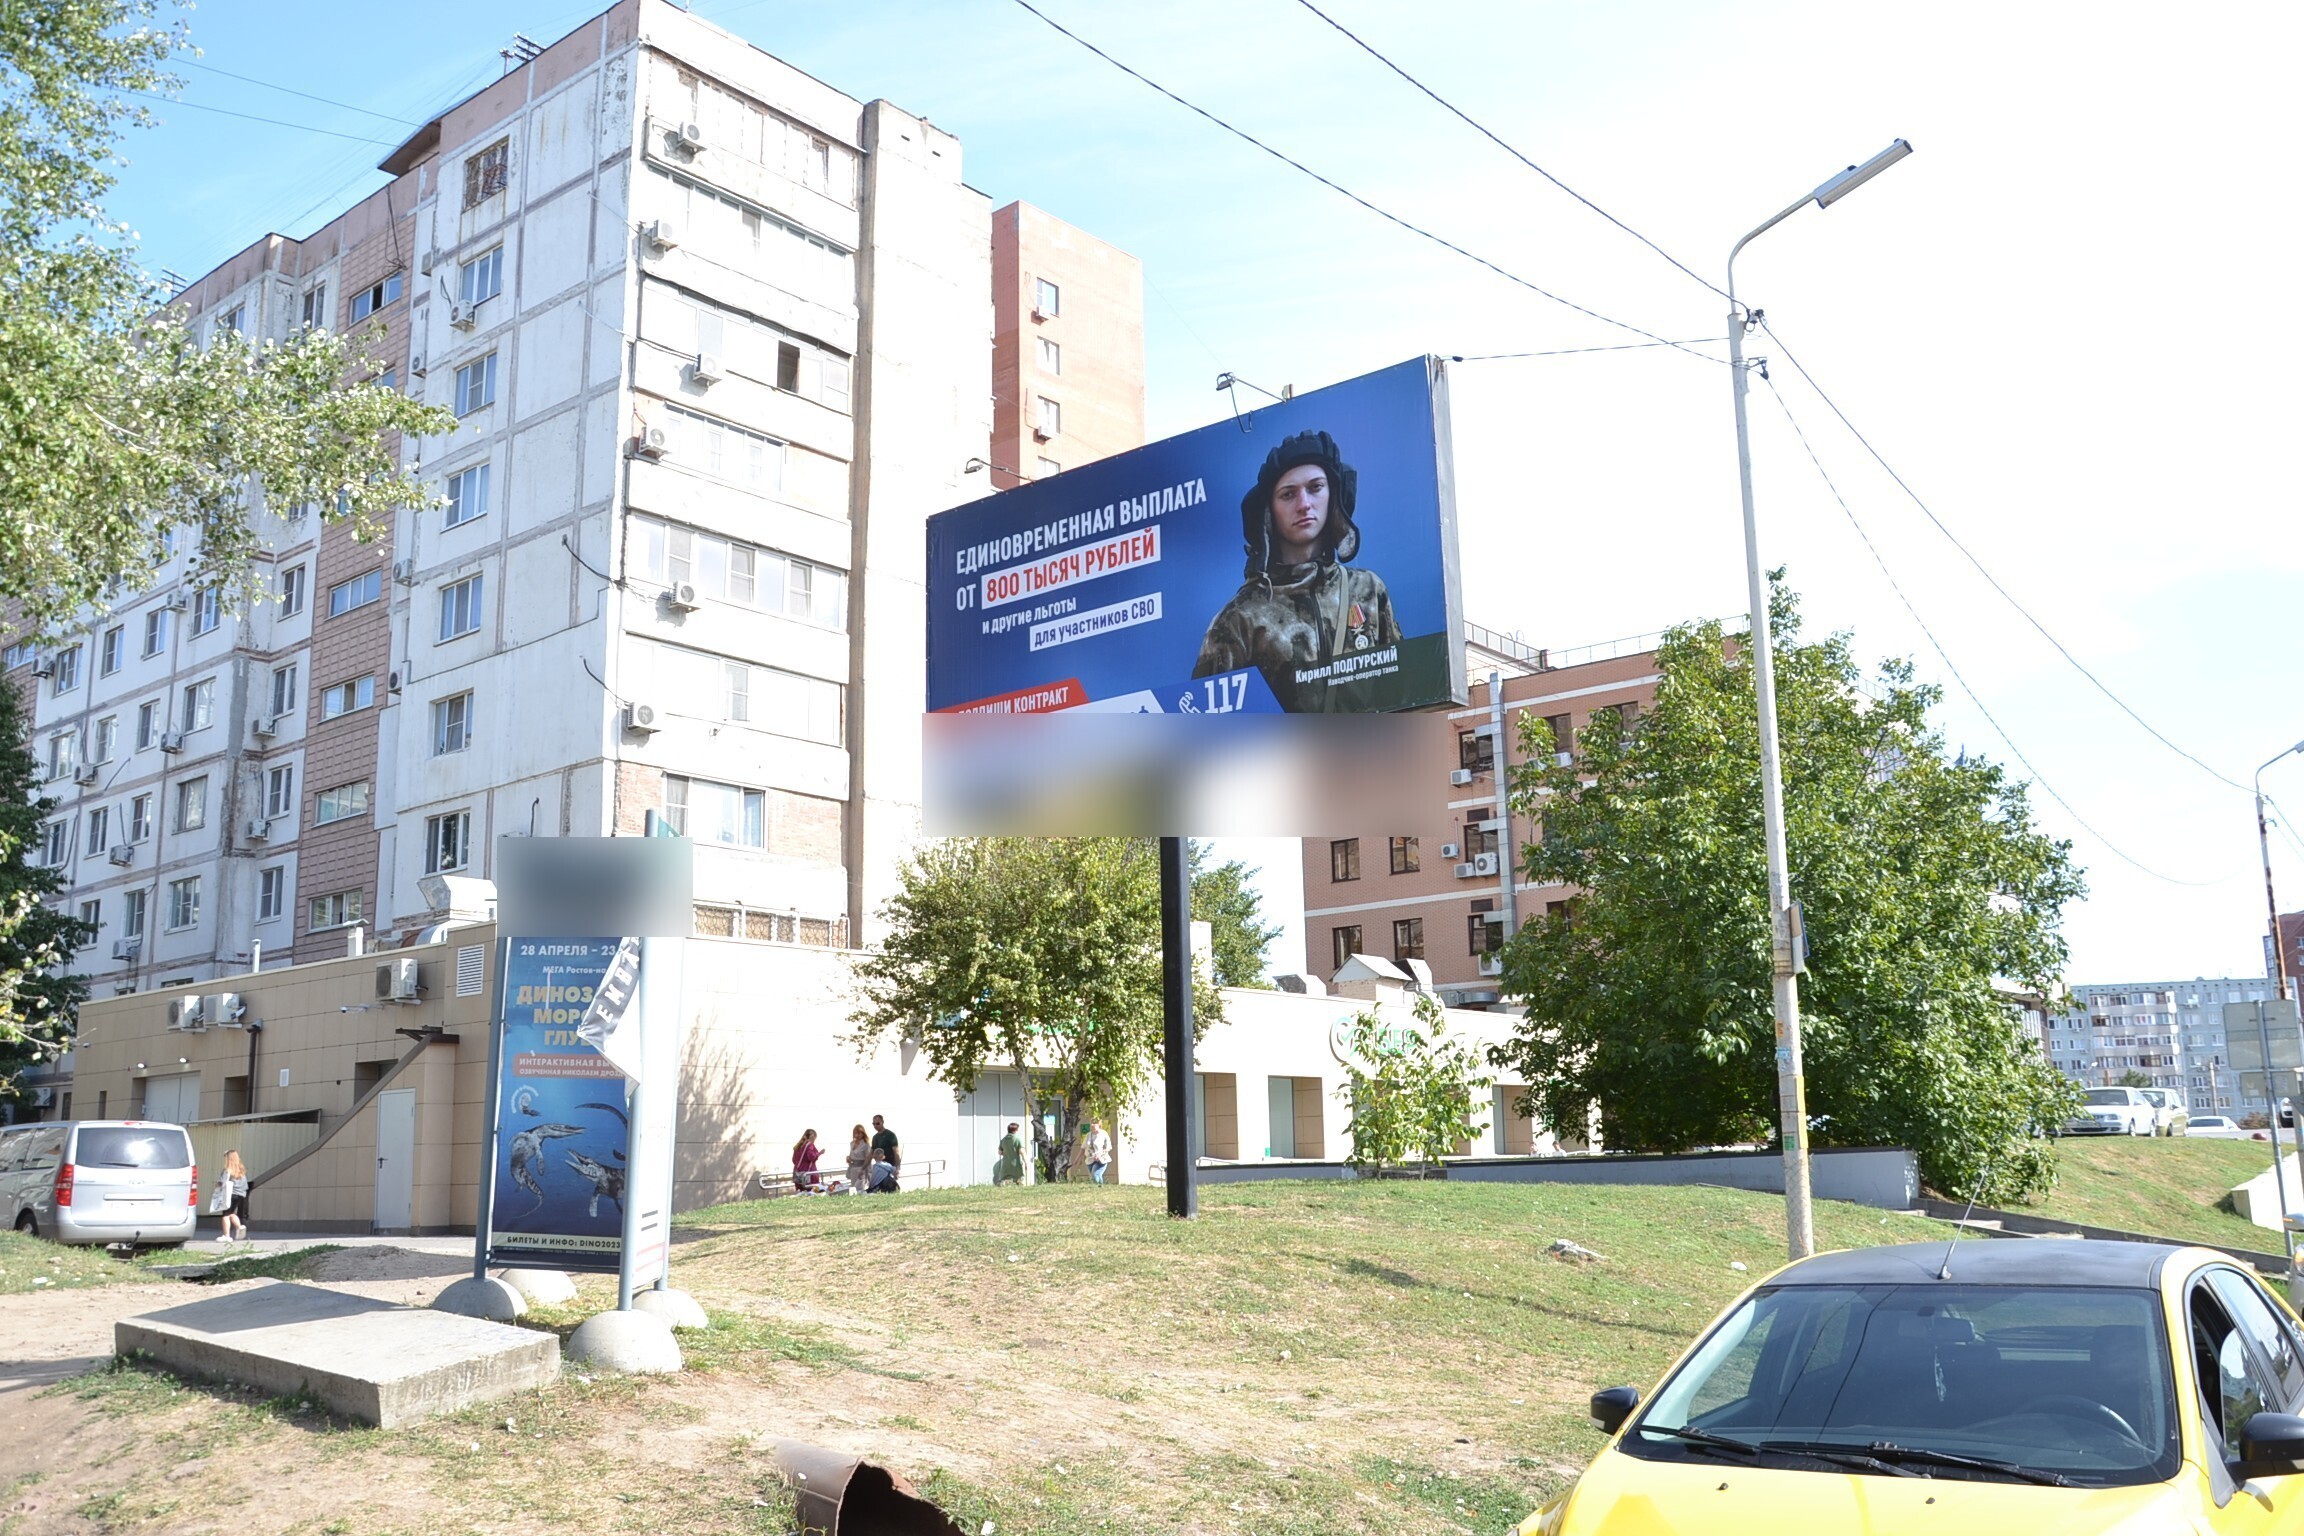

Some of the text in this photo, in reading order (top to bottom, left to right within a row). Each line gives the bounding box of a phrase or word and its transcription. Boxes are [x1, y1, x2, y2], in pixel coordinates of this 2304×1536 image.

[957, 478, 1207, 575] ЕДИНОВРЕМЕННАЯ ВЫПЛАТА
[956, 527, 1155, 611] ОТ 800 ТЫСЯЧ РУБЛЕЙ
[982, 597, 1077, 634] и другие льготы
[1034, 598, 1155, 647] для участников СВО
[1295, 645, 1398, 684] Кирилл ПОДГУРСКИЙ
[1382, 665, 1399, 674] танка
[1013, 687, 1069, 713] КОНТРАКТ
[1204, 672, 1248, 713] 117
[520, 945, 535, 956] 28
[538, 945, 588, 956] АПРЕЛЯ
[601, 945, 616, 956] 23
[542, 965, 564, 974] МЕГА
[516, 985, 601, 1005] ДИНОЗ
[519, 1058, 594, 1067] ИНТЕРАКТИВНАЯ
[507, 1236, 539, 1244] БИЛЕТЫ
[549, 1238, 578, 1247] ИНФО:
